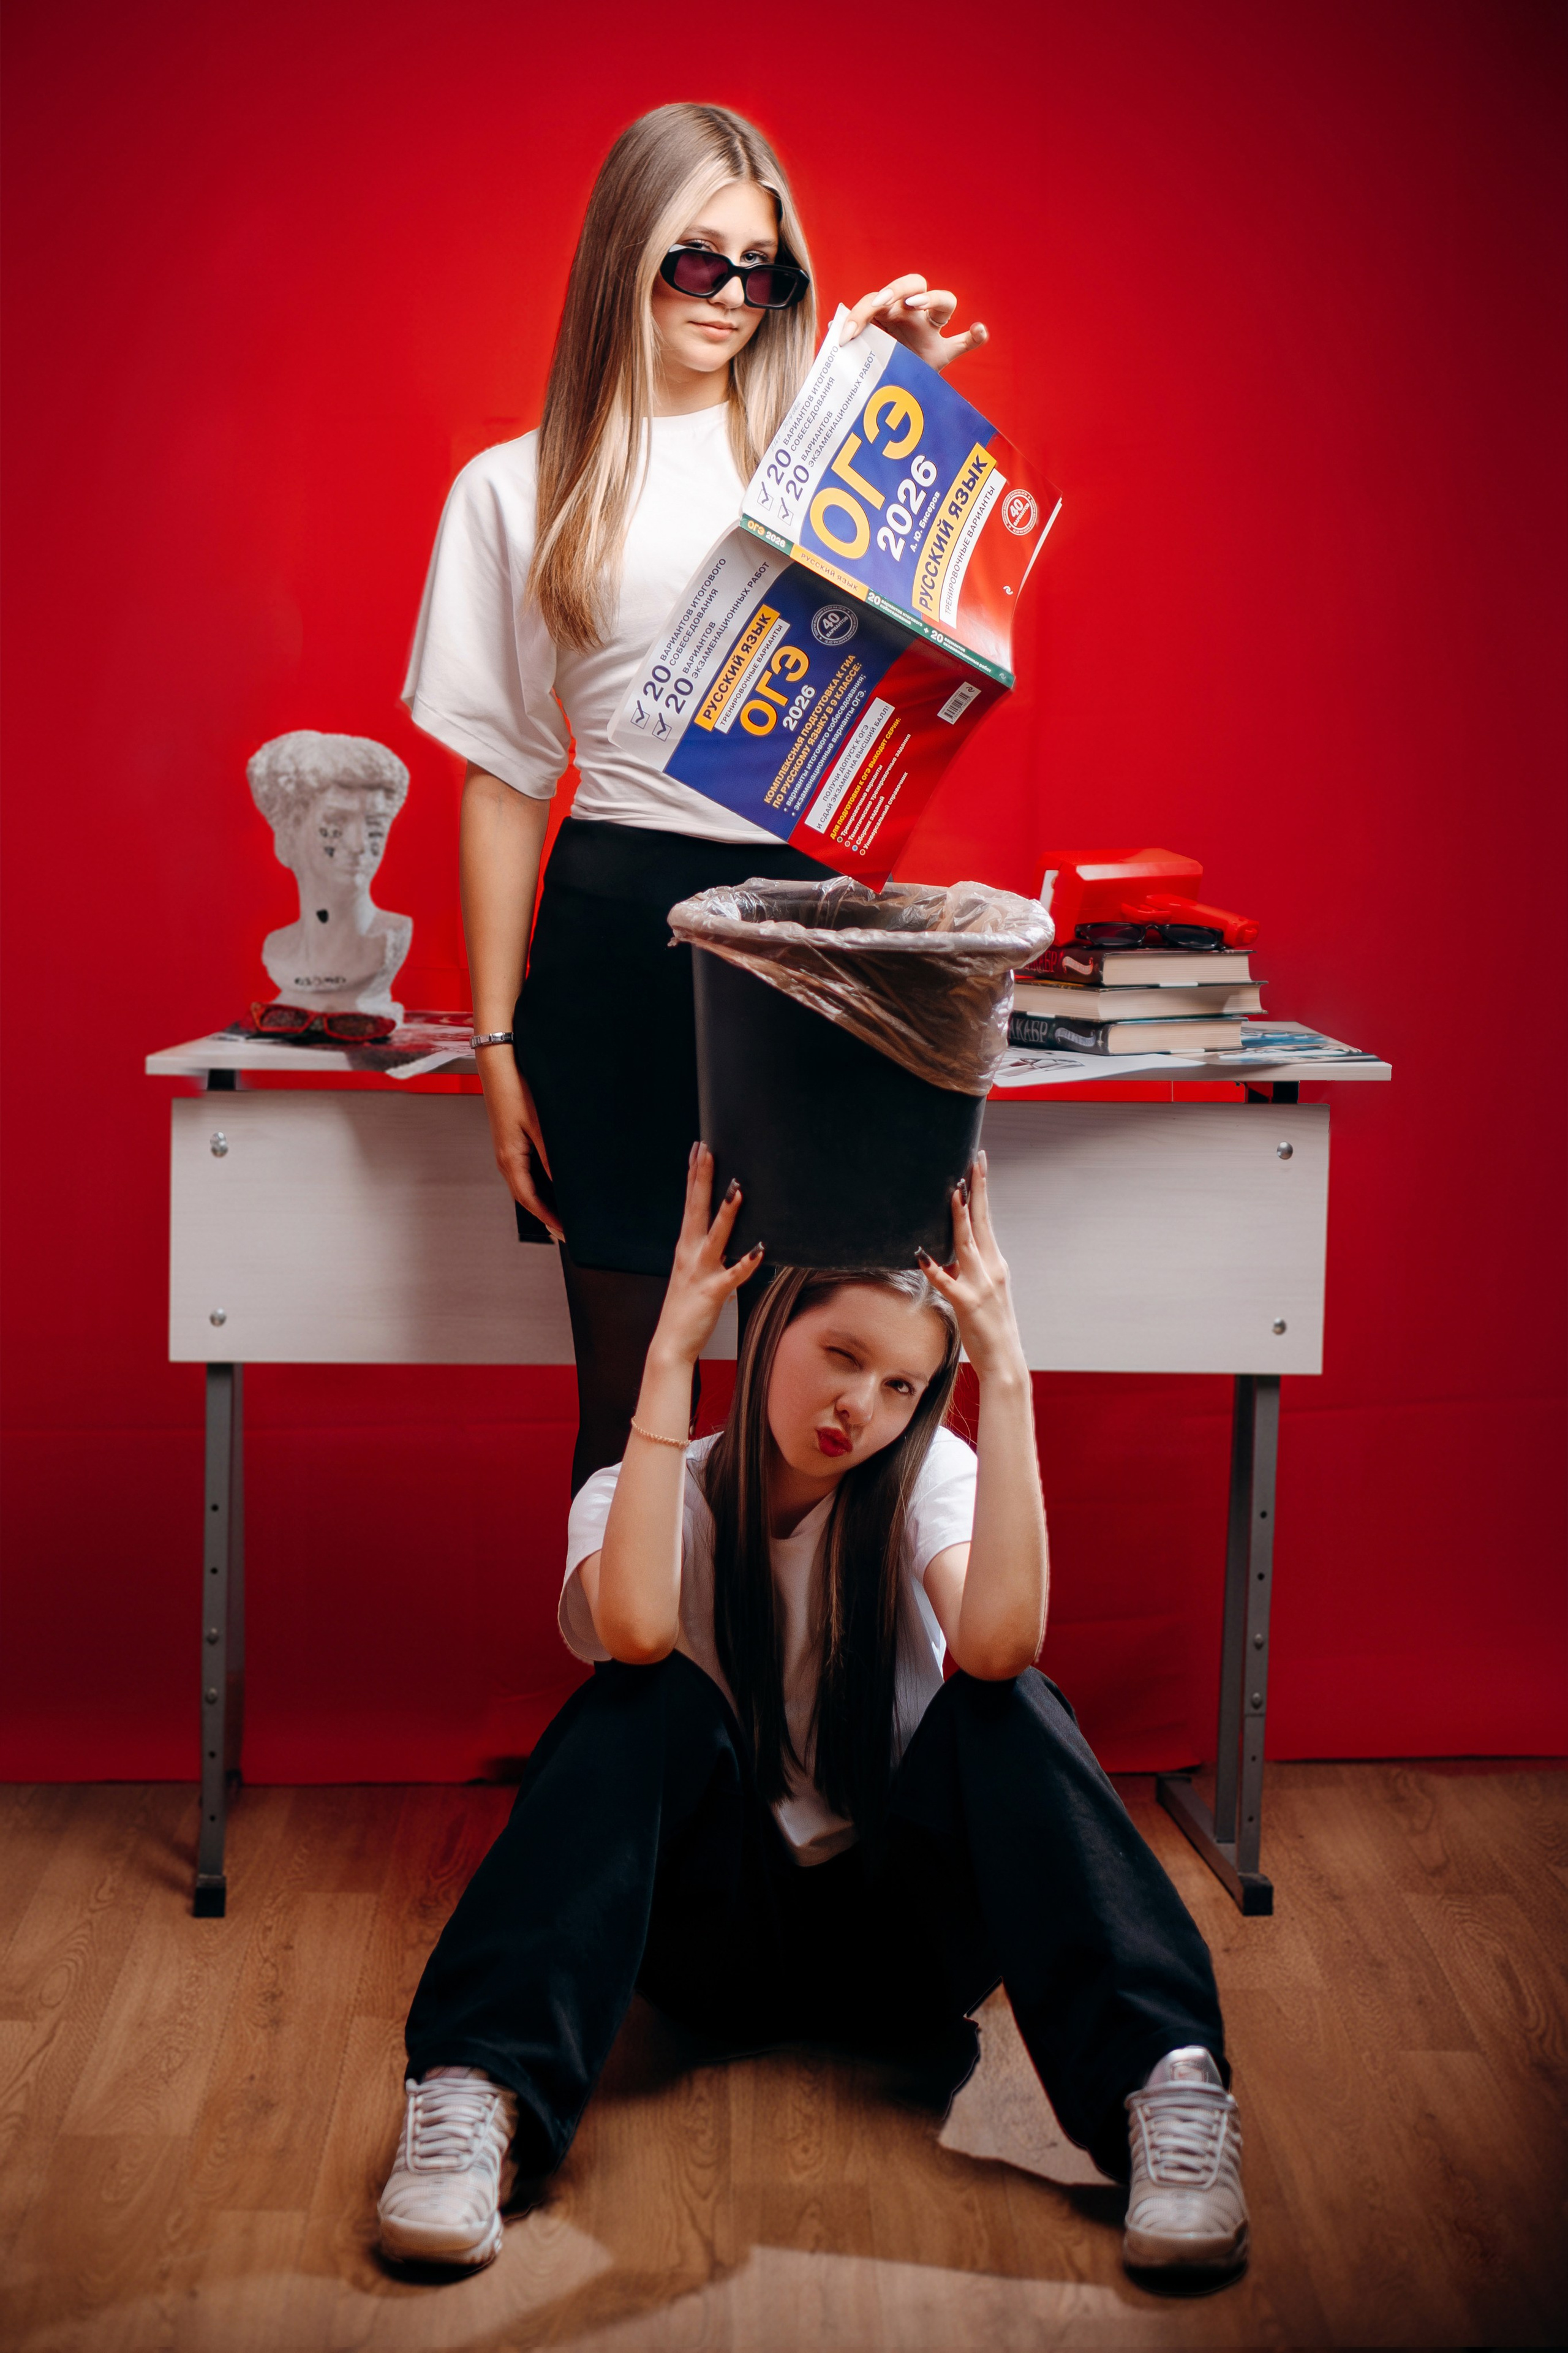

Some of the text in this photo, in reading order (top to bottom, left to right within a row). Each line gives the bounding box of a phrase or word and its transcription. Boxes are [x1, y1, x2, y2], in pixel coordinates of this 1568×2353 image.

[766, 346, 839, 485] 20 ВАРИАНТОВ ИТОГОВОГО
[790, 377, 835, 451] СОБЕСЕДОВАНИЯ
[808, 350, 876, 467] ЭКЗАМЕНАЦИОННЫХ РАБОТ
[785, 410, 833, 501] 20 ВАРИАНТОВ
[810, 387, 924, 558] ОГЭ
[747, 519, 786, 548] ОГЭ 2026
[876, 455, 938, 561] 2026
[913, 530, 923, 542] Ю.
[919, 491, 940, 528] Бисеров
[919, 454, 987, 611] РУССКИЙ ЯЗЫК
[945, 485, 995, 613] ТРЕНИРОВОЧНЫЕ ВАРИАНТЫ
[1010, 499, 1023, 517] 40
[1012, 502, 1030, 526] ВАРИАНТОВ
[801, 553, 858, 591] РУССКИЙ ЯЗЫК
[867, 592, 881, 605] 20
[881, 599, 903, 614] вариантов
[880, 603, 911, 625] собеседования
[643, 558, 726, 701] 20 ВАРИАНТОВ ИТОГОВОГО
[669, 588, 718, 666] СОБЕСЕДОВАНИЯ
[692, 561, 769, 679] ЭКЗАМЕНАЦИОННЫХ РАБОТ
[823, 613, 839, 629] 40
[826, 616, 848, 637] ВАРИАНТОВ
[930, 630, 966, 652] 20 вариантов
[665, 621, 716, 714] 20 ВАРИАНТОВ
[703, 613, 771, 720] РУССКИЙ ЯЗЫК
[720, 624, 783, 725] ТРЕНИРОВОЧНЫЕ ВАРИАНТЫ
[740, 646, 808, 735] ОГЭ
[782, 685, 815, 731] 2026
[978, 663, 992, 673] работ
[764, 736, 805, 803] КОМПЛЕКСНАЯ
[801, 679, 840, 737] ПОДГОТОВКА
[835, 670, 844, 679] К
[840, 655, 855, 672] ГИА
[772, 663, 862, 808] ПО РУССКОМУ ЯЗЫКУ В 9 КЛАССЕ:
[786, 674, 866, 806] варианты итогового собеседования;
[794, 690, 866, 810] экзаменационные варианты ОГЭ.
[820, 803, 833, 823] СДАЙ
[831, 769, 852, 803] ЭКЗАМЕН
[849, 760, 858, 769] НА
[855, 727, 876, 758] ВЫСШИЙ
[874, 705, 889, 727] БАЛЛ!
[822, 772, 841, 801] ПОЛУЧИ
[839, 744, 858, 773] ДОПУСК
[858, 724, 869, 739] ОГЭ
[830, 824, 840, 839] ДЛЯ
[837, 785, 862, 825] ПОДГОТОВКИ
[861, 768, 871, 780] ОГЭ
[868, 738, 888, 768] ВЫХОДЯТ
[885, 717, 901, 739] СЕРИИ:
[840, 764, 883, 836] Тренировочные варианты
[848, 733, 911, 840] Тематические тренировочные задания
[856, 796, 885, 845] Сборник заданий
[863, 771, 908, 849] Универсальный справочник
[1008, 1018, 1048, 1043] АКАБР
